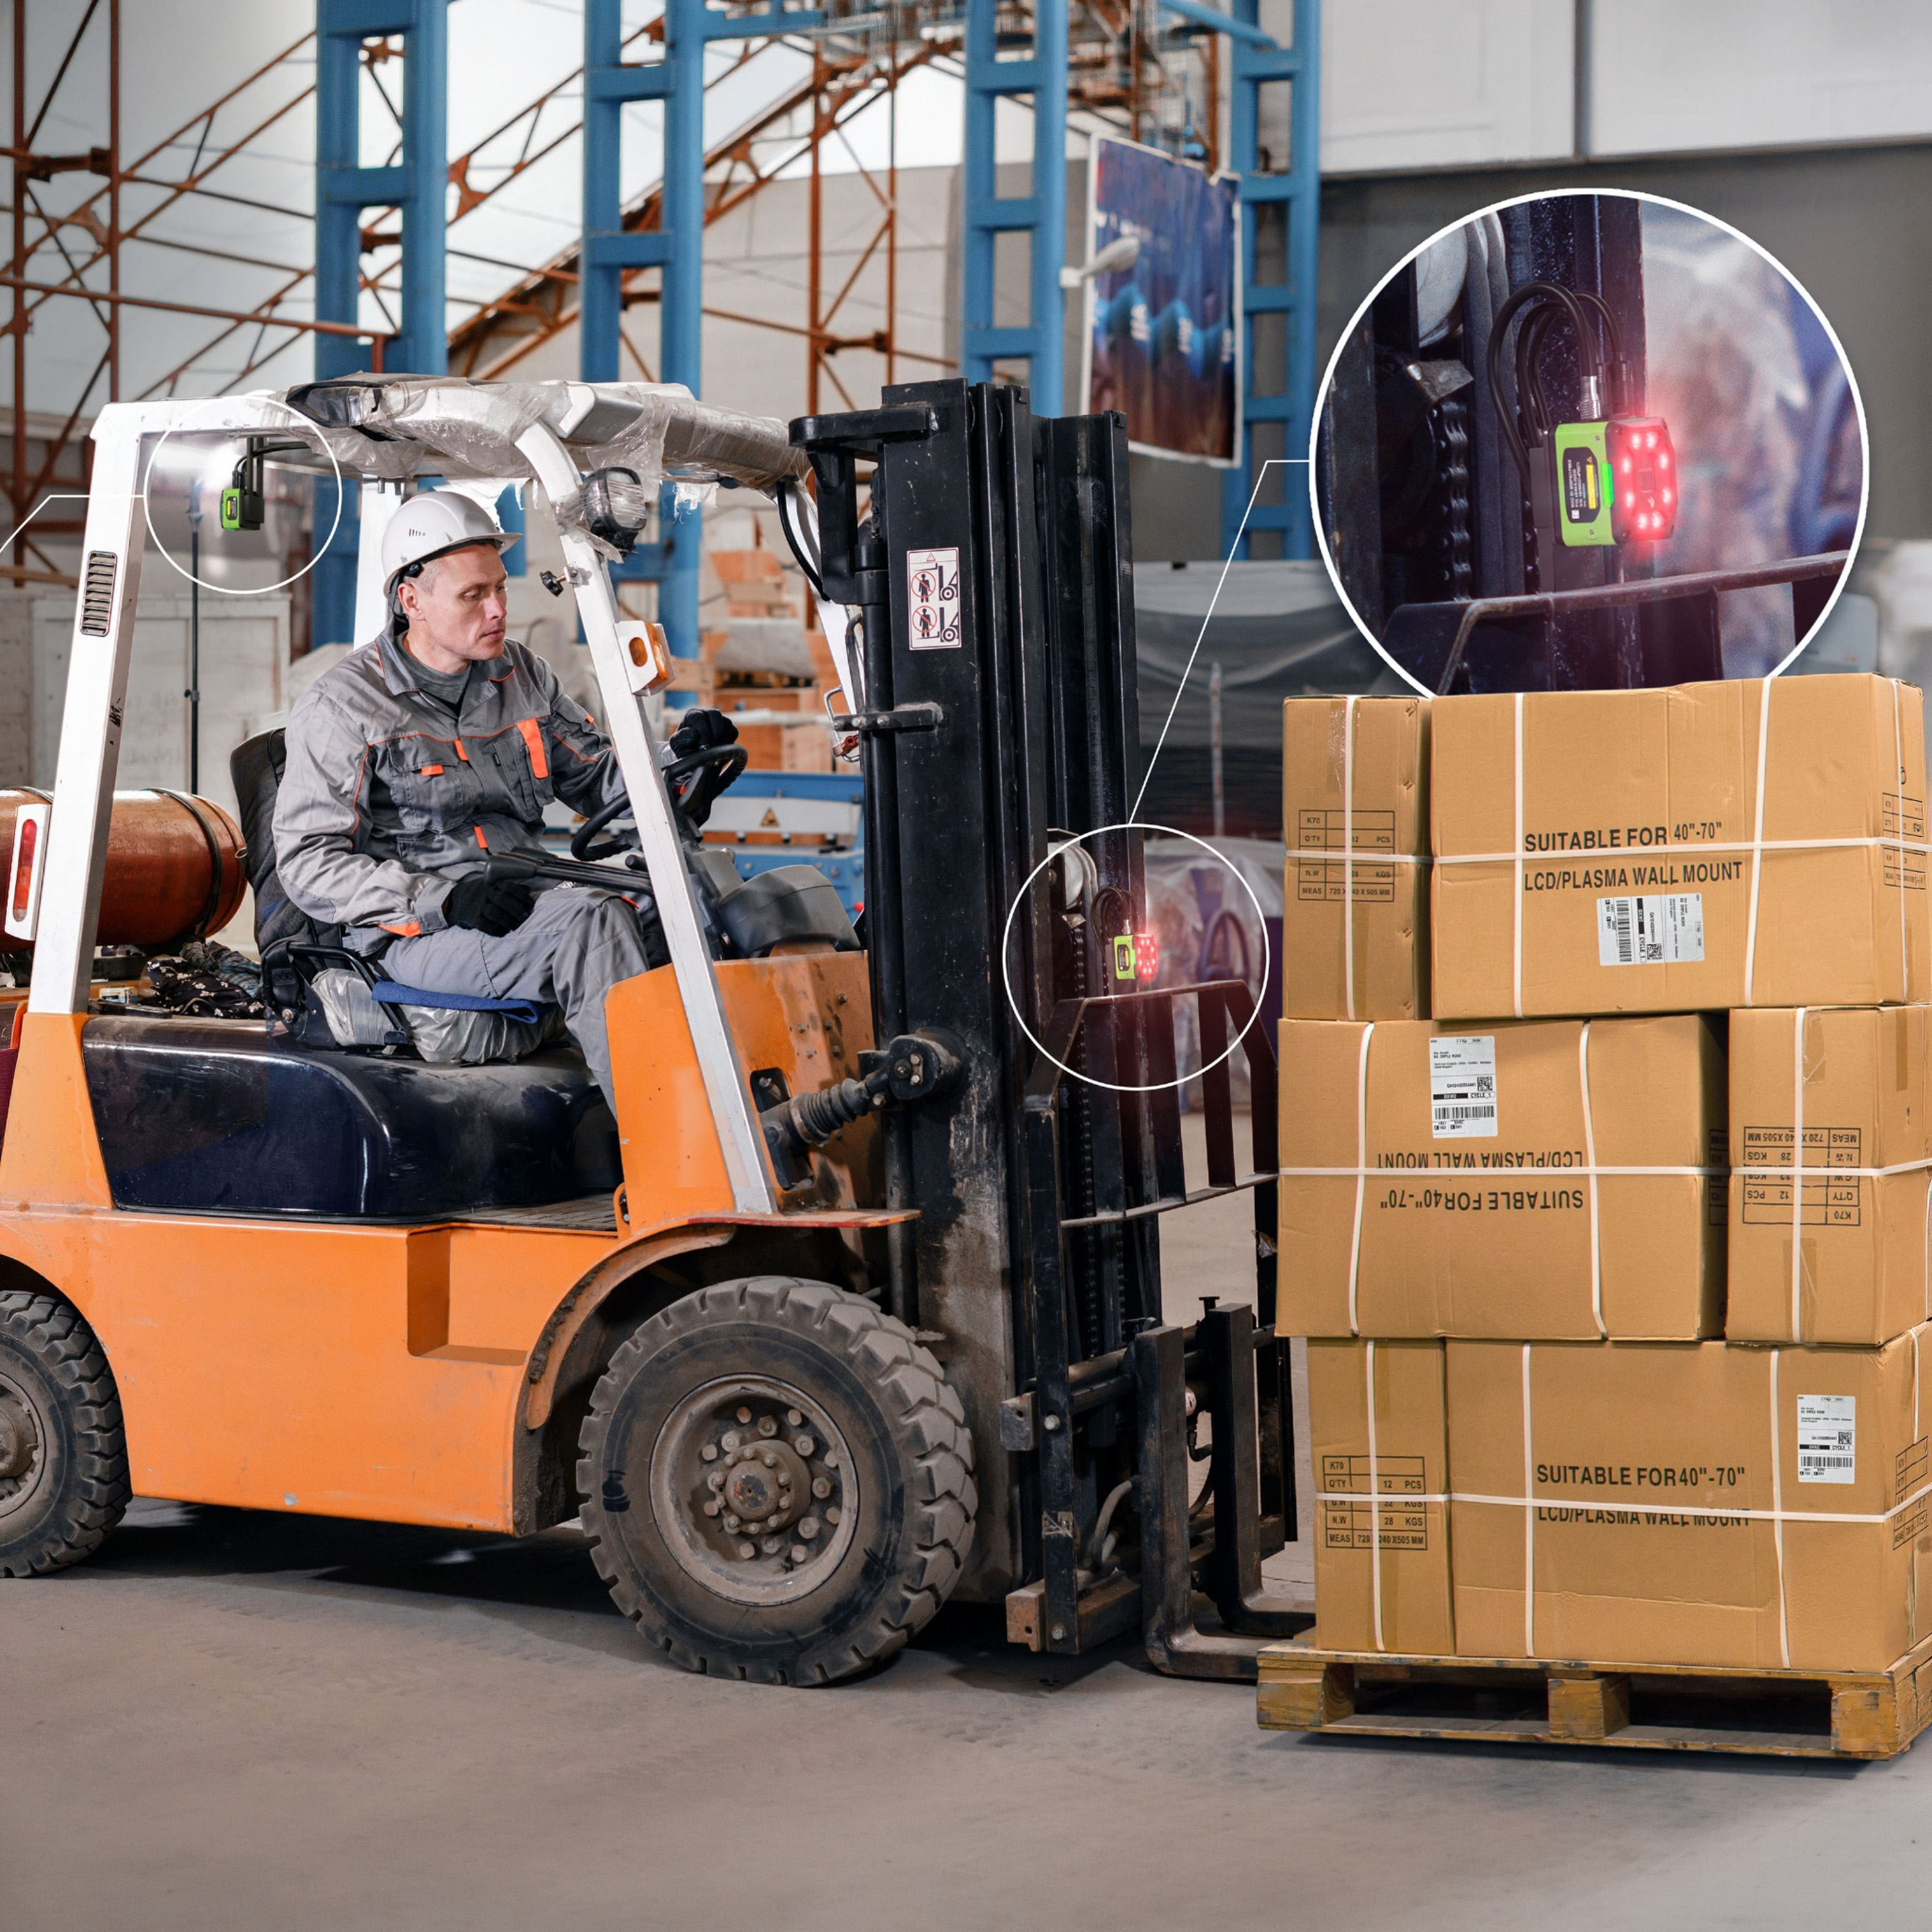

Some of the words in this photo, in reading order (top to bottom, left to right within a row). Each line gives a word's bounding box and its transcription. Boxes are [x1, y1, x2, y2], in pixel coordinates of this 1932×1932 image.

[1525, 829, 1621, 852] SUITABLE
[1627, 826, 1668, 847] FOR
[1674, 821, 1722, 840] 40"-70"
[1525, 868, 1628, 891] LCD/PLASMA
[1633, 865, 1678, 886] WALL
[1683, 861, 1742, 883] MOUNT
[1833, 1134, 1857, 1143] MEAS
[1376, 1152, 1428, 1169] MOUNT
[1434, 1152, 1476, 1168] WALL
[1481, 1151, 1582, 1168] LCD/PLASMA
[1444, 1192, 1482, 1211] FOR
[1488, 1190, 1584, 1210] SUITABLE
[1780, 1191, 1789, 1200] 12
[1329, 1479, 1346, 1488] Q'TY
[1405, 1481, 1422, 1489] PCS
[1537, 1464, 1631, 1485] SUITABLE
[1637, 1467, 1676, 1487] FOR
[1406, 1517, 1423, 1526] KGS
[1538, 1506, 1640, 1525] LCD/PLASMA
[1645, 1512, 1689, 1527] WALL
[1693, 1508, 1750, 1527] MOUNT
[1358, 1535, 1370, 1543] 720
[1412, 1536, 1424, 1544] MM
